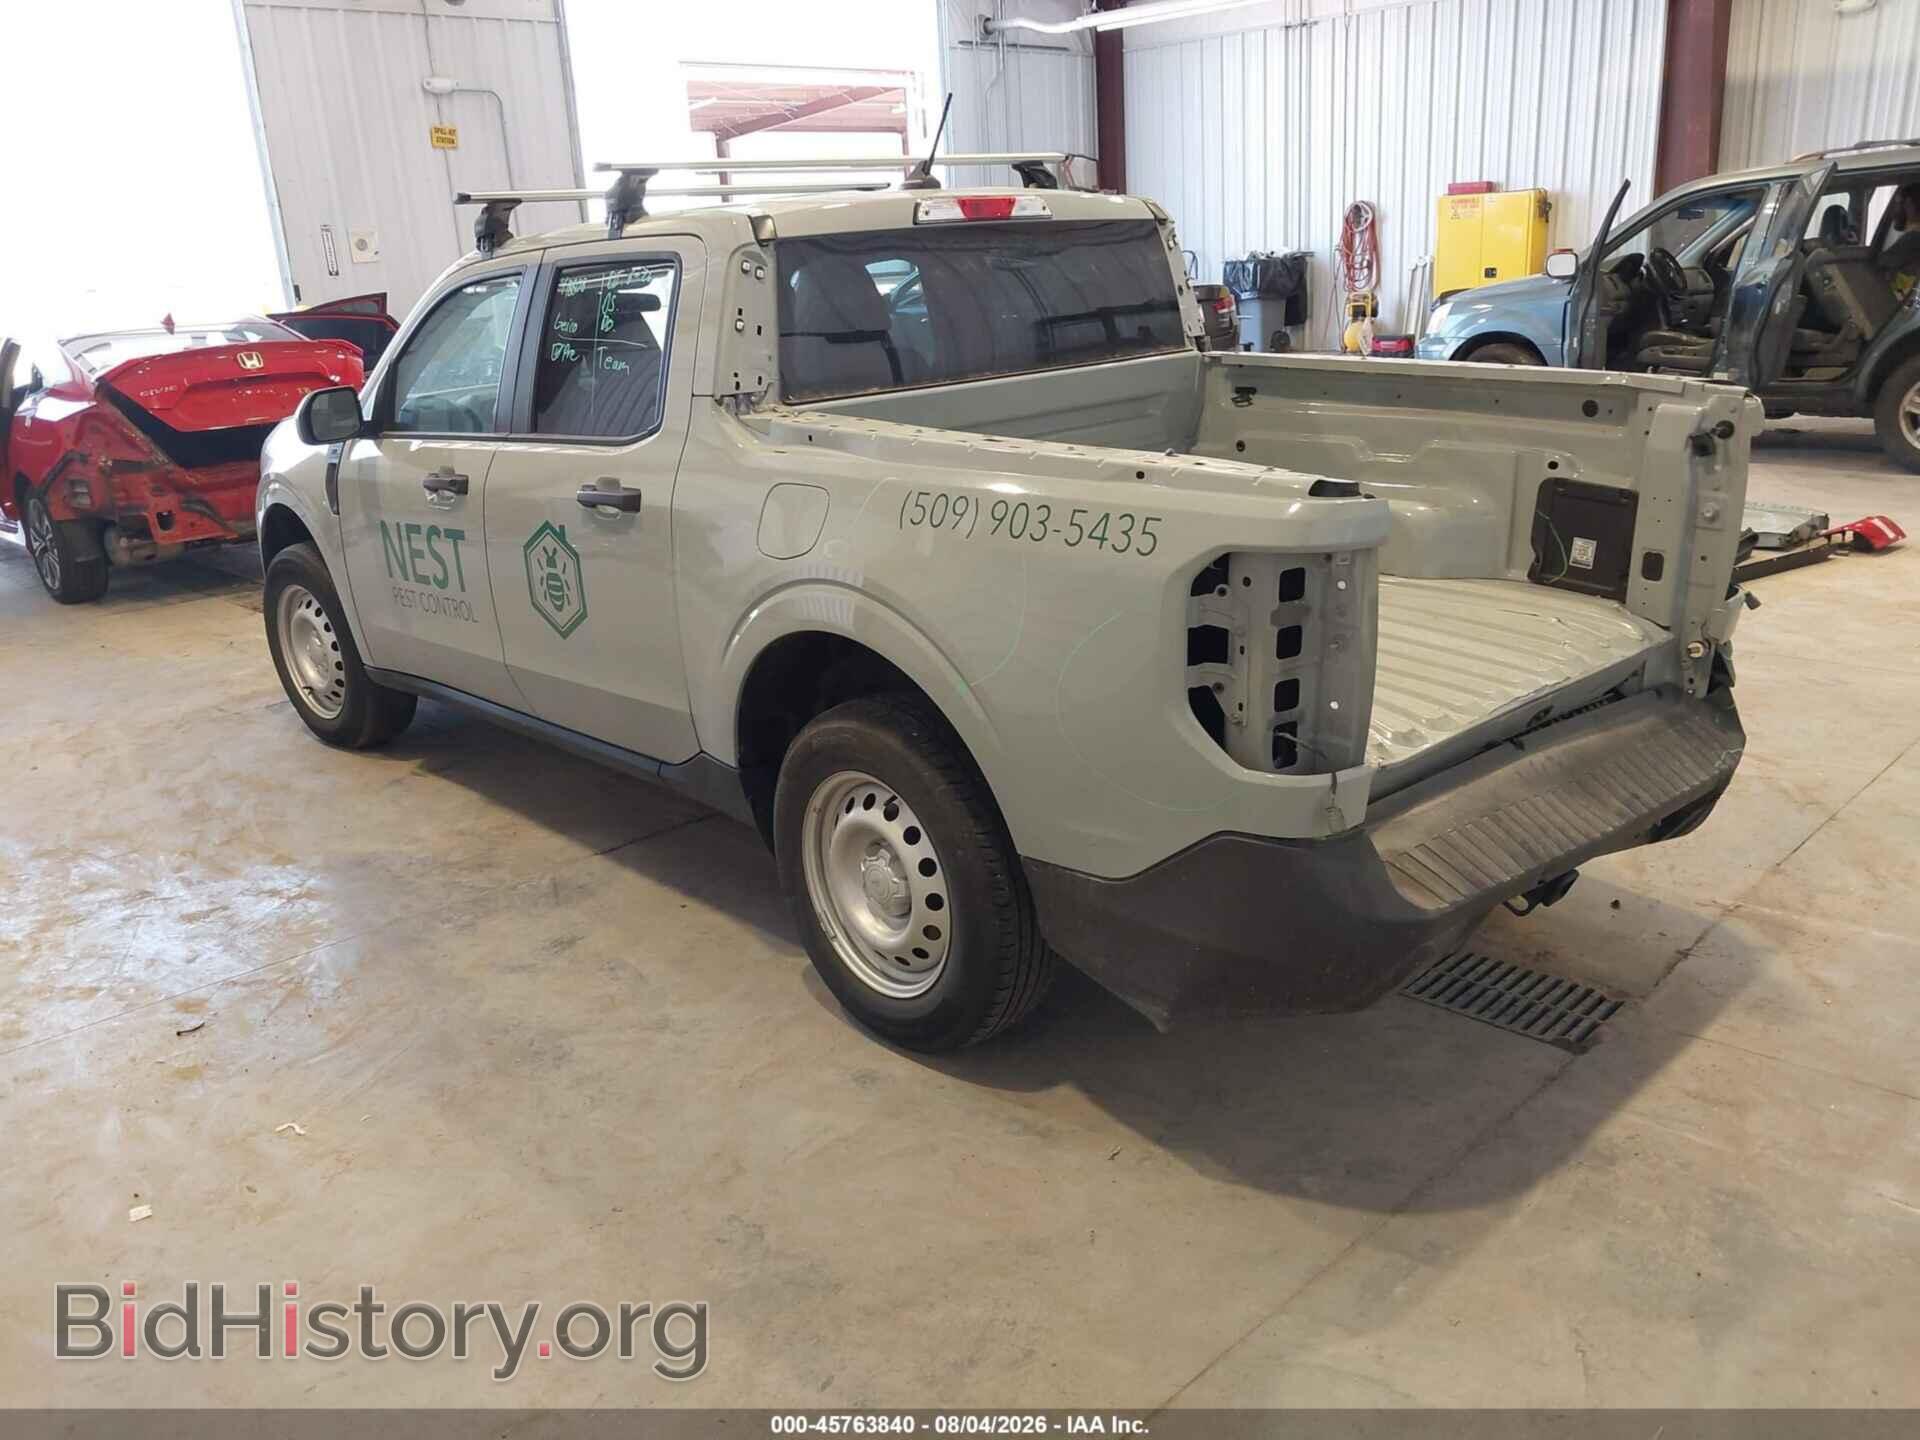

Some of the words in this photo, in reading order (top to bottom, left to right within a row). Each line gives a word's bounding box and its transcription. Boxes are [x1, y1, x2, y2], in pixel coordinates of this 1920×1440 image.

[436, 136, 455, 144] STATION
[597, 346, 630, 376] Team
[899, 489, 979, 540] (509)
[990, 499, 1162, 557] 903-5435
[379, 519, 466, 593] NEST
[391, 586, 417, 608] PEST
[419, 592, 480, 624] CONTROL
